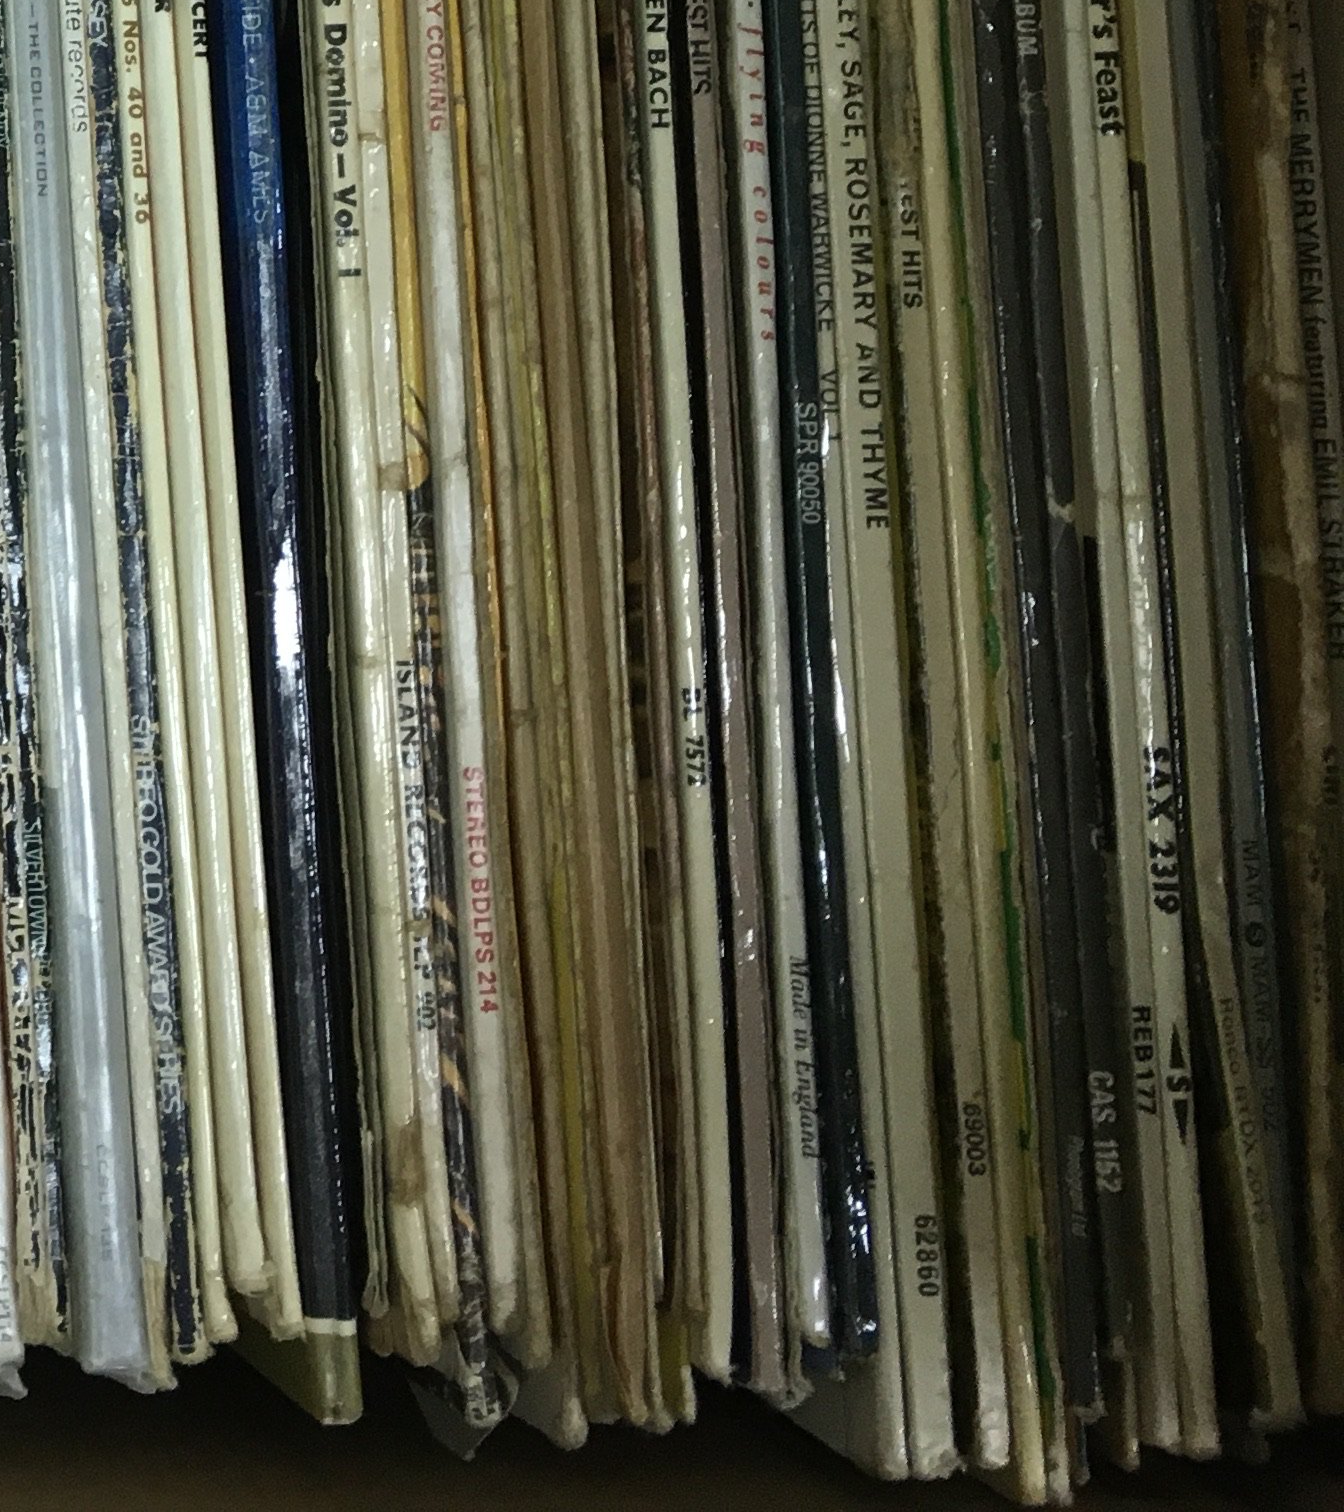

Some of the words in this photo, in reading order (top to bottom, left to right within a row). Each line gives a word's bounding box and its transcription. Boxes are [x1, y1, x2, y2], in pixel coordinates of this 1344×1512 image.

[325, 23, 354, 147] Domino
[648, 49, 669, 129] BACH
[839, 60, 865, 148] SAGE,
[1095, 50, 1124, 136] Feast
[845, 157, 878, 330] ROSEMARY
[858, 342, 883, 409] AND
[861, 421, 889, 530] THYME
[469, 878, 494, 963] BDLPS
[477, 971, 498, 1013] 214
[915, 1214, 940, 1297] 62860
